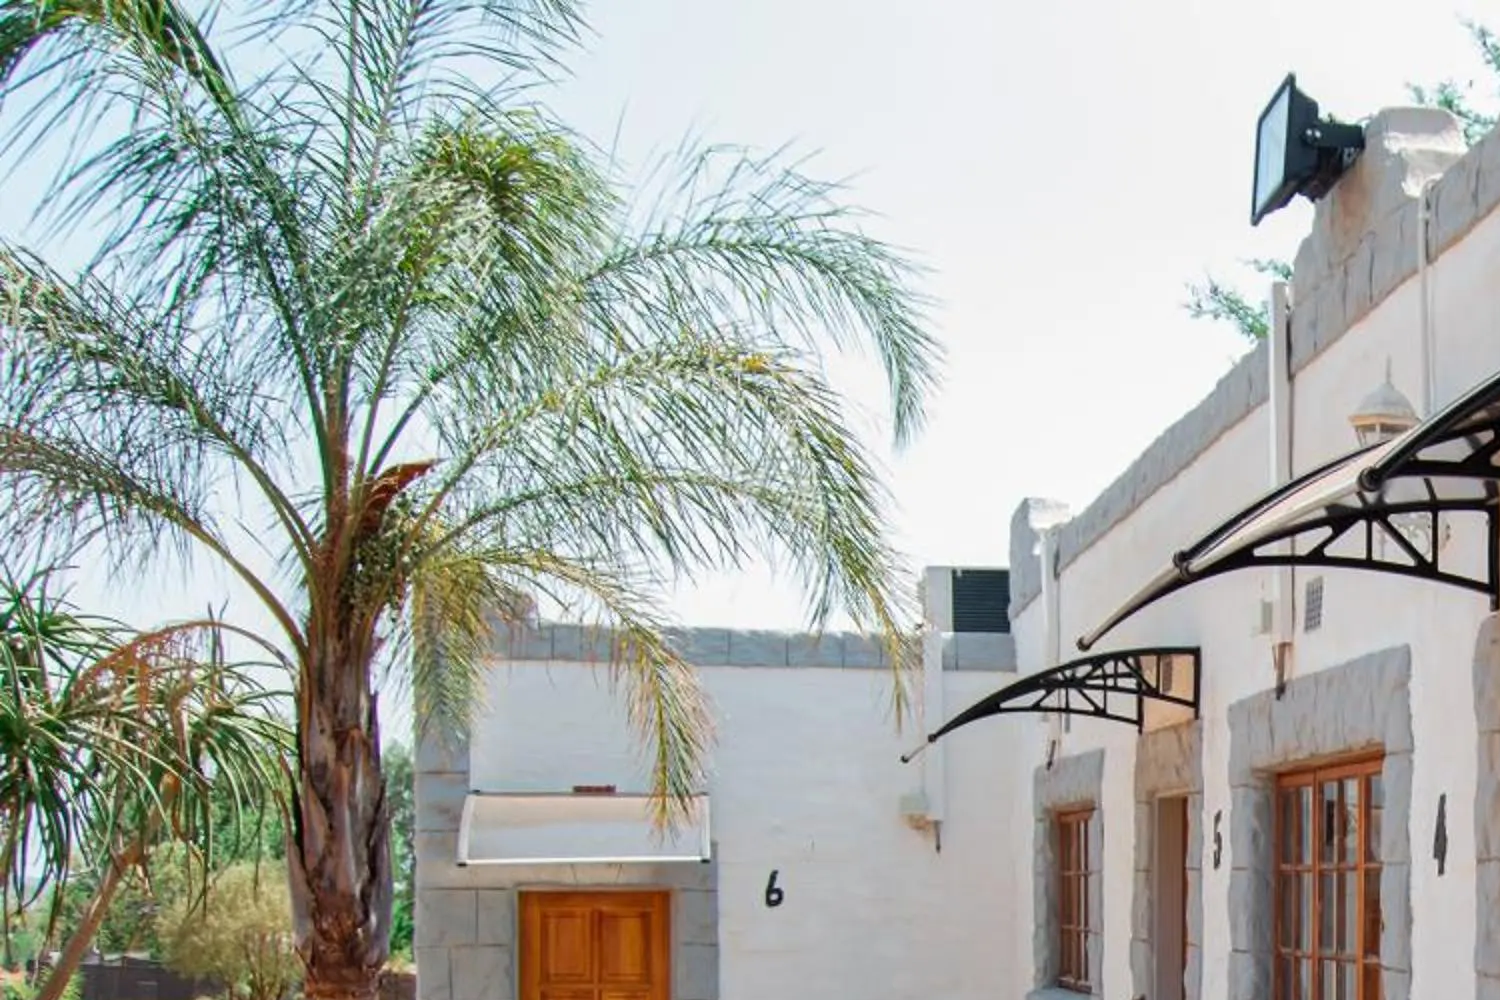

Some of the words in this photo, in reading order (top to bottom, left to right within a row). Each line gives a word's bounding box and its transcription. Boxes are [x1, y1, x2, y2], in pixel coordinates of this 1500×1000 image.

[1213, 810, 1222, 870] 5
[1433, 794, 1448, 876] 4
[765, 870, 784, 908] 6
